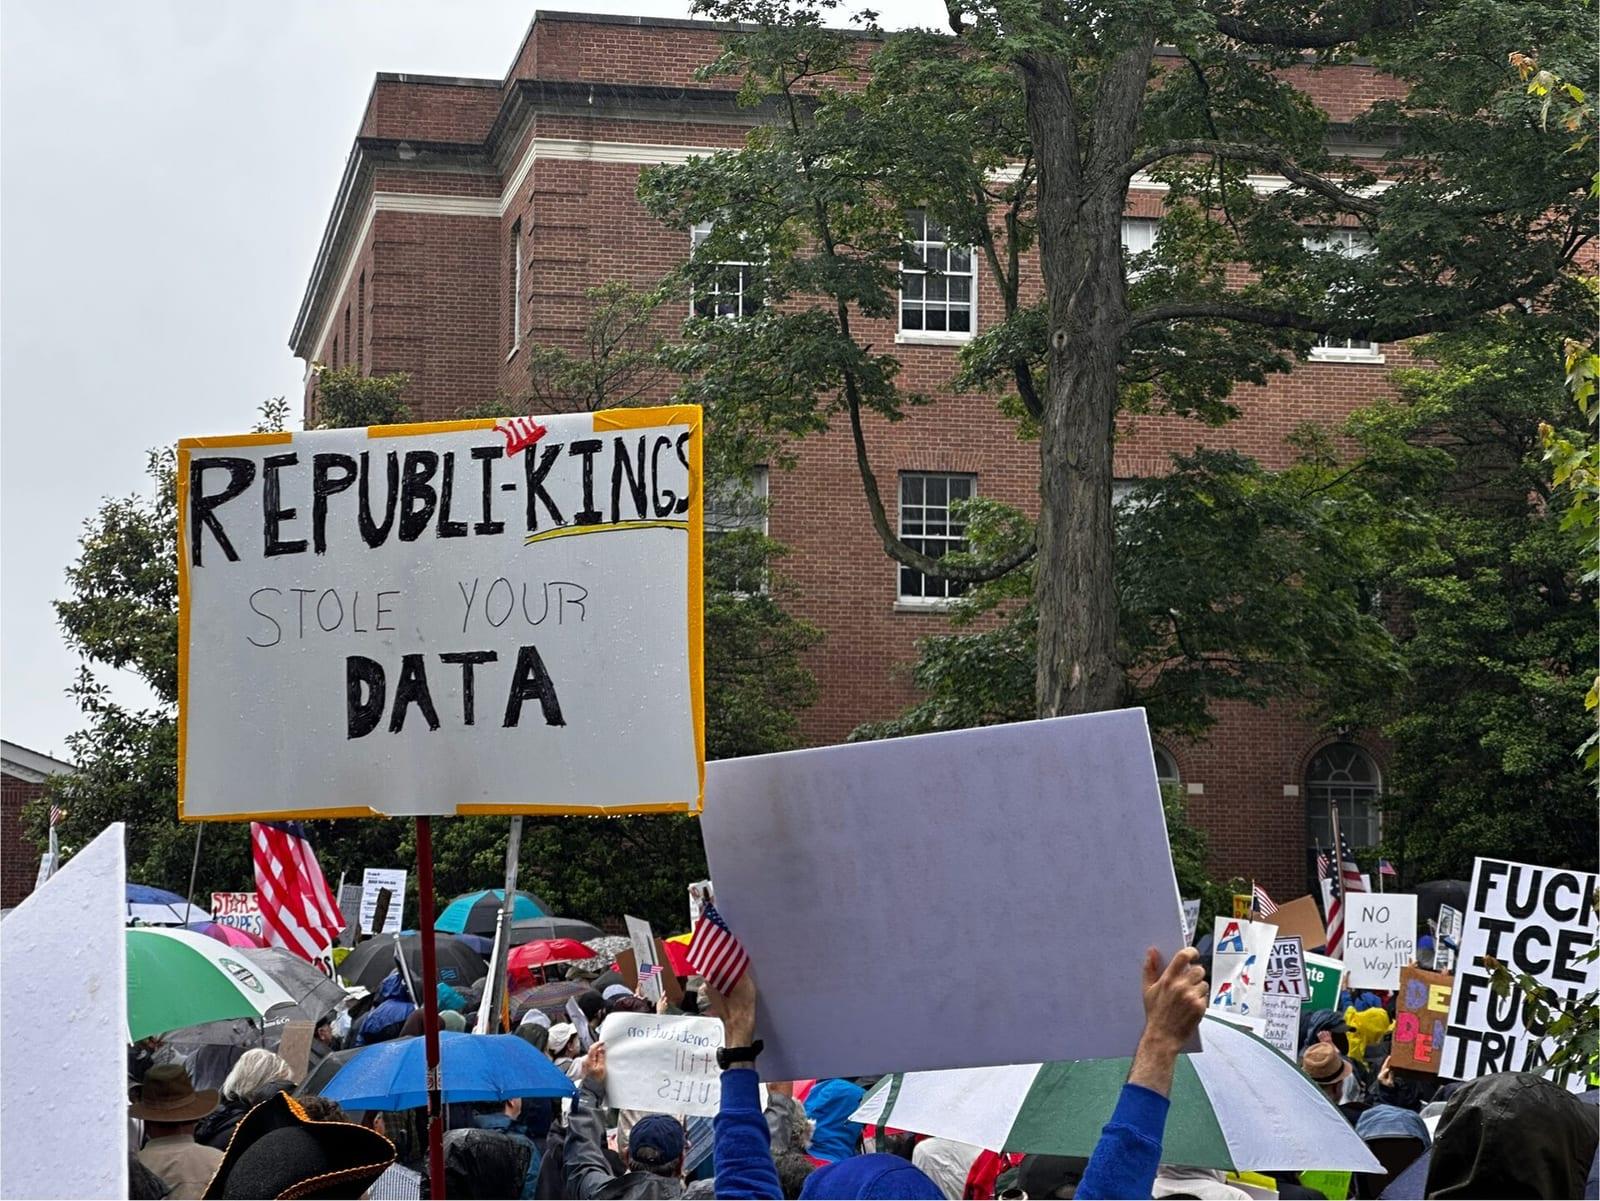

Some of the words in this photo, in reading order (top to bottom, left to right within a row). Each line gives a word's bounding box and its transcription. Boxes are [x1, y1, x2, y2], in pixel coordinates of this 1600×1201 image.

[190, 431, 690, 567] REPUBLI-KINGS
[246, 586, 401, 647] STOLE
[458, 577, 588, 632] YOUR
[346, 645, 567, 740] DATA
[216, 915, 262, 936] TRIPES
[1361, 906, 1390, 923] NO
[1472, 916, 1594, 984] ICE
